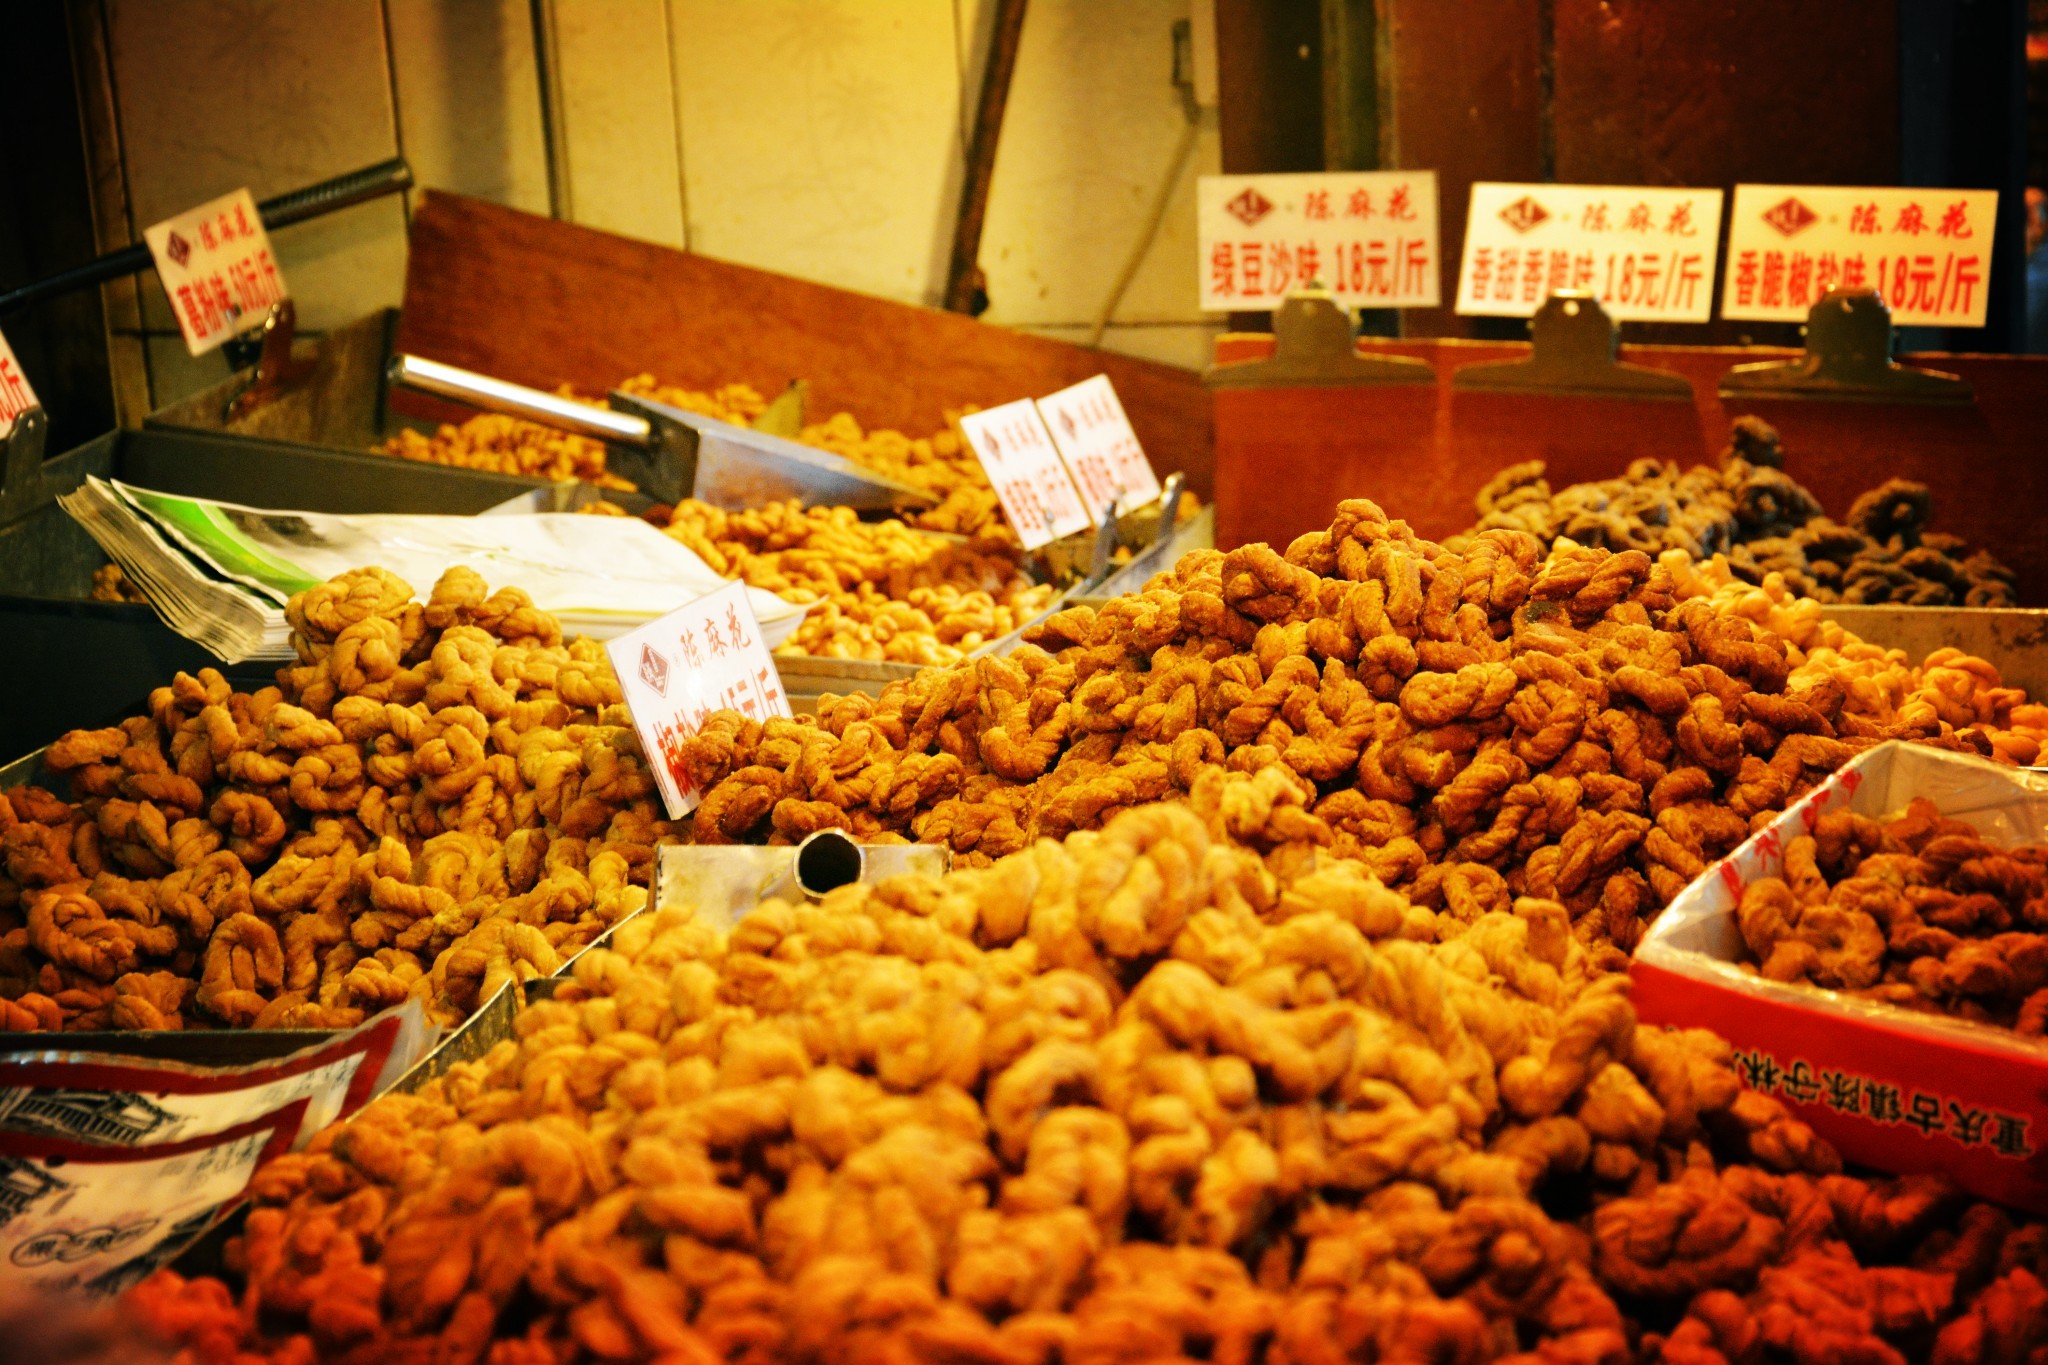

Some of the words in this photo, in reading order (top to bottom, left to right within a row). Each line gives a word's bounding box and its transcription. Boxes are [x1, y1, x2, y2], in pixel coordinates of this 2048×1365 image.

[1303, 184, 1417, 220] 陈麻花
[1581, 200, 1698, 237] 陈麻花
[1849, 199, 1973, 239] 陈麻花
[1212, 241, 1320, 297] 绿豆沙味
[1336, 236, 1429, 297] 18元/斤
[1600, 250, 1703, 311] 18元/斤
[1876, 252, 1981, 316] 18元/斤
[680, 602, 752, 670] 陈麻花
[1727, 1052, 2032, 1156] 重庆古镇陈守林
